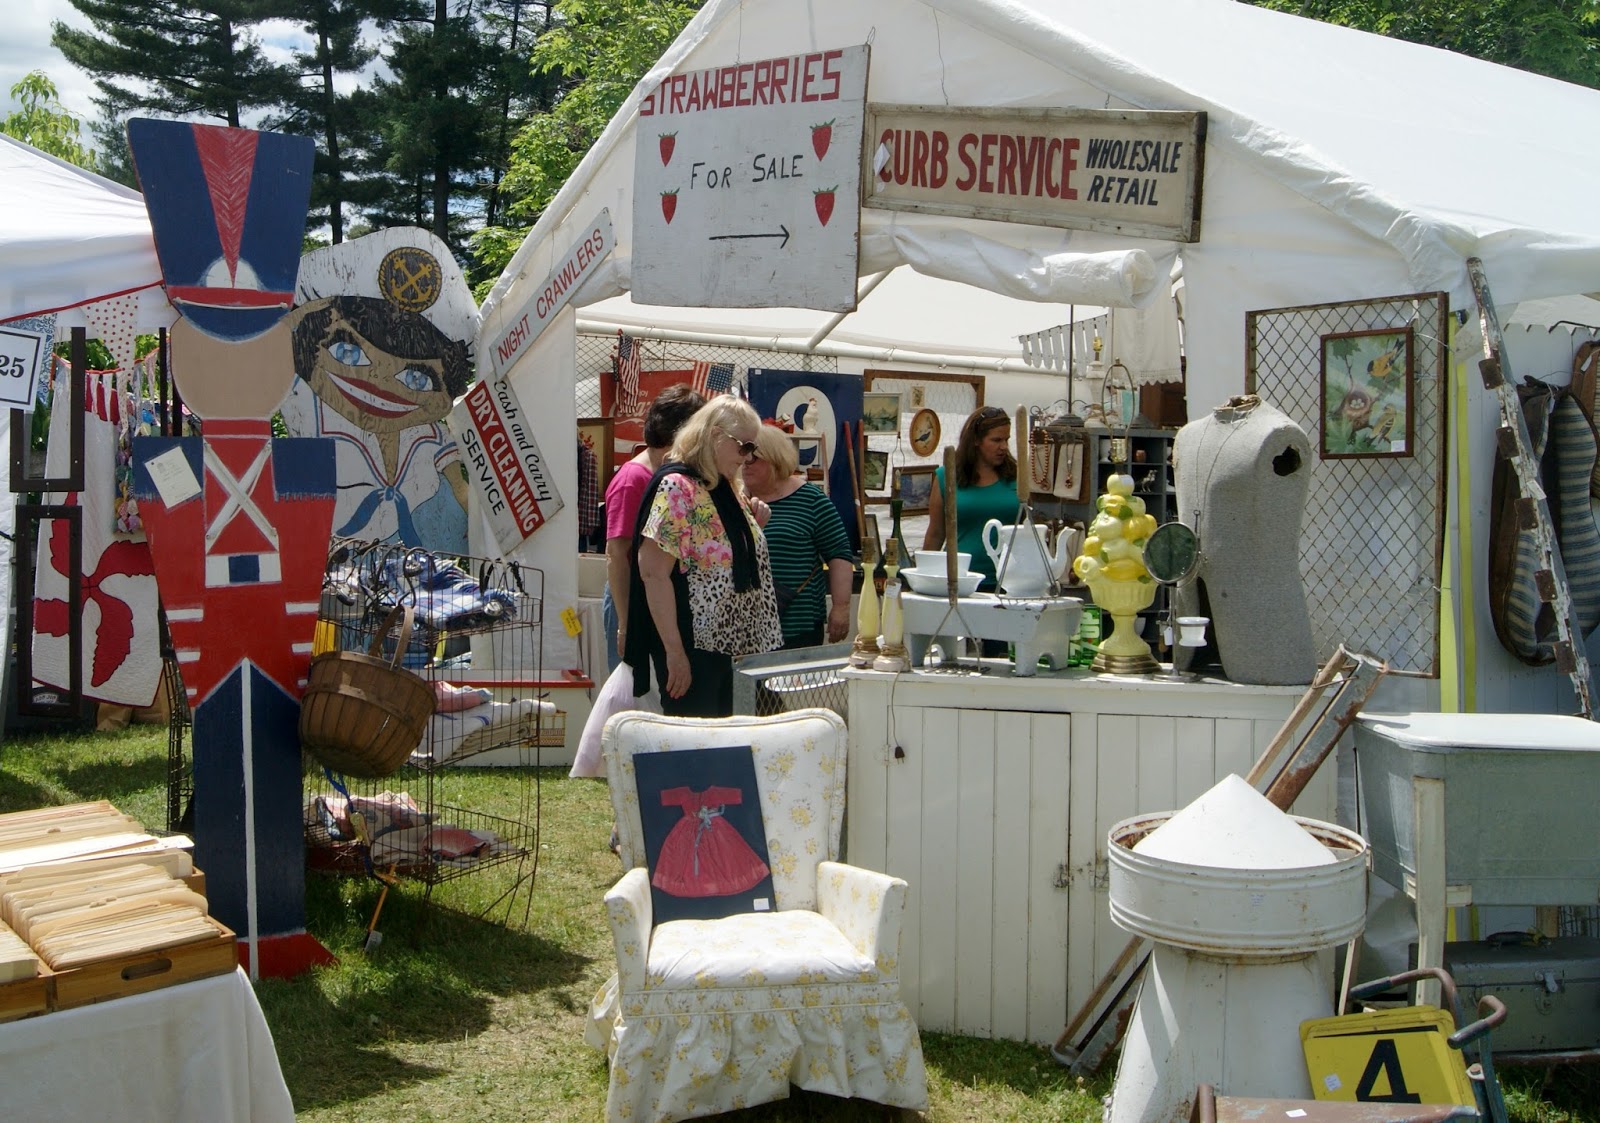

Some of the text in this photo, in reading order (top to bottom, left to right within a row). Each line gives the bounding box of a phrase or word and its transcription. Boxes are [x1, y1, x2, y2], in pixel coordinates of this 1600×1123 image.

[690, 153, 804, 190] FOR SALE
[879, 128, 1080, 201] CURB SERVICE
[1085, 138, 1183, 173] WHOLESALE
[1086, 175, 1159, 206] RETAIL
[497, 228, 604, 365] NIGHT CRAWLERS
[461, 428, 505, 516] SERVICE
[469, 388, 540, 532] DRY CLEANING
[494, 380, 552, 502] Cash and Carry
